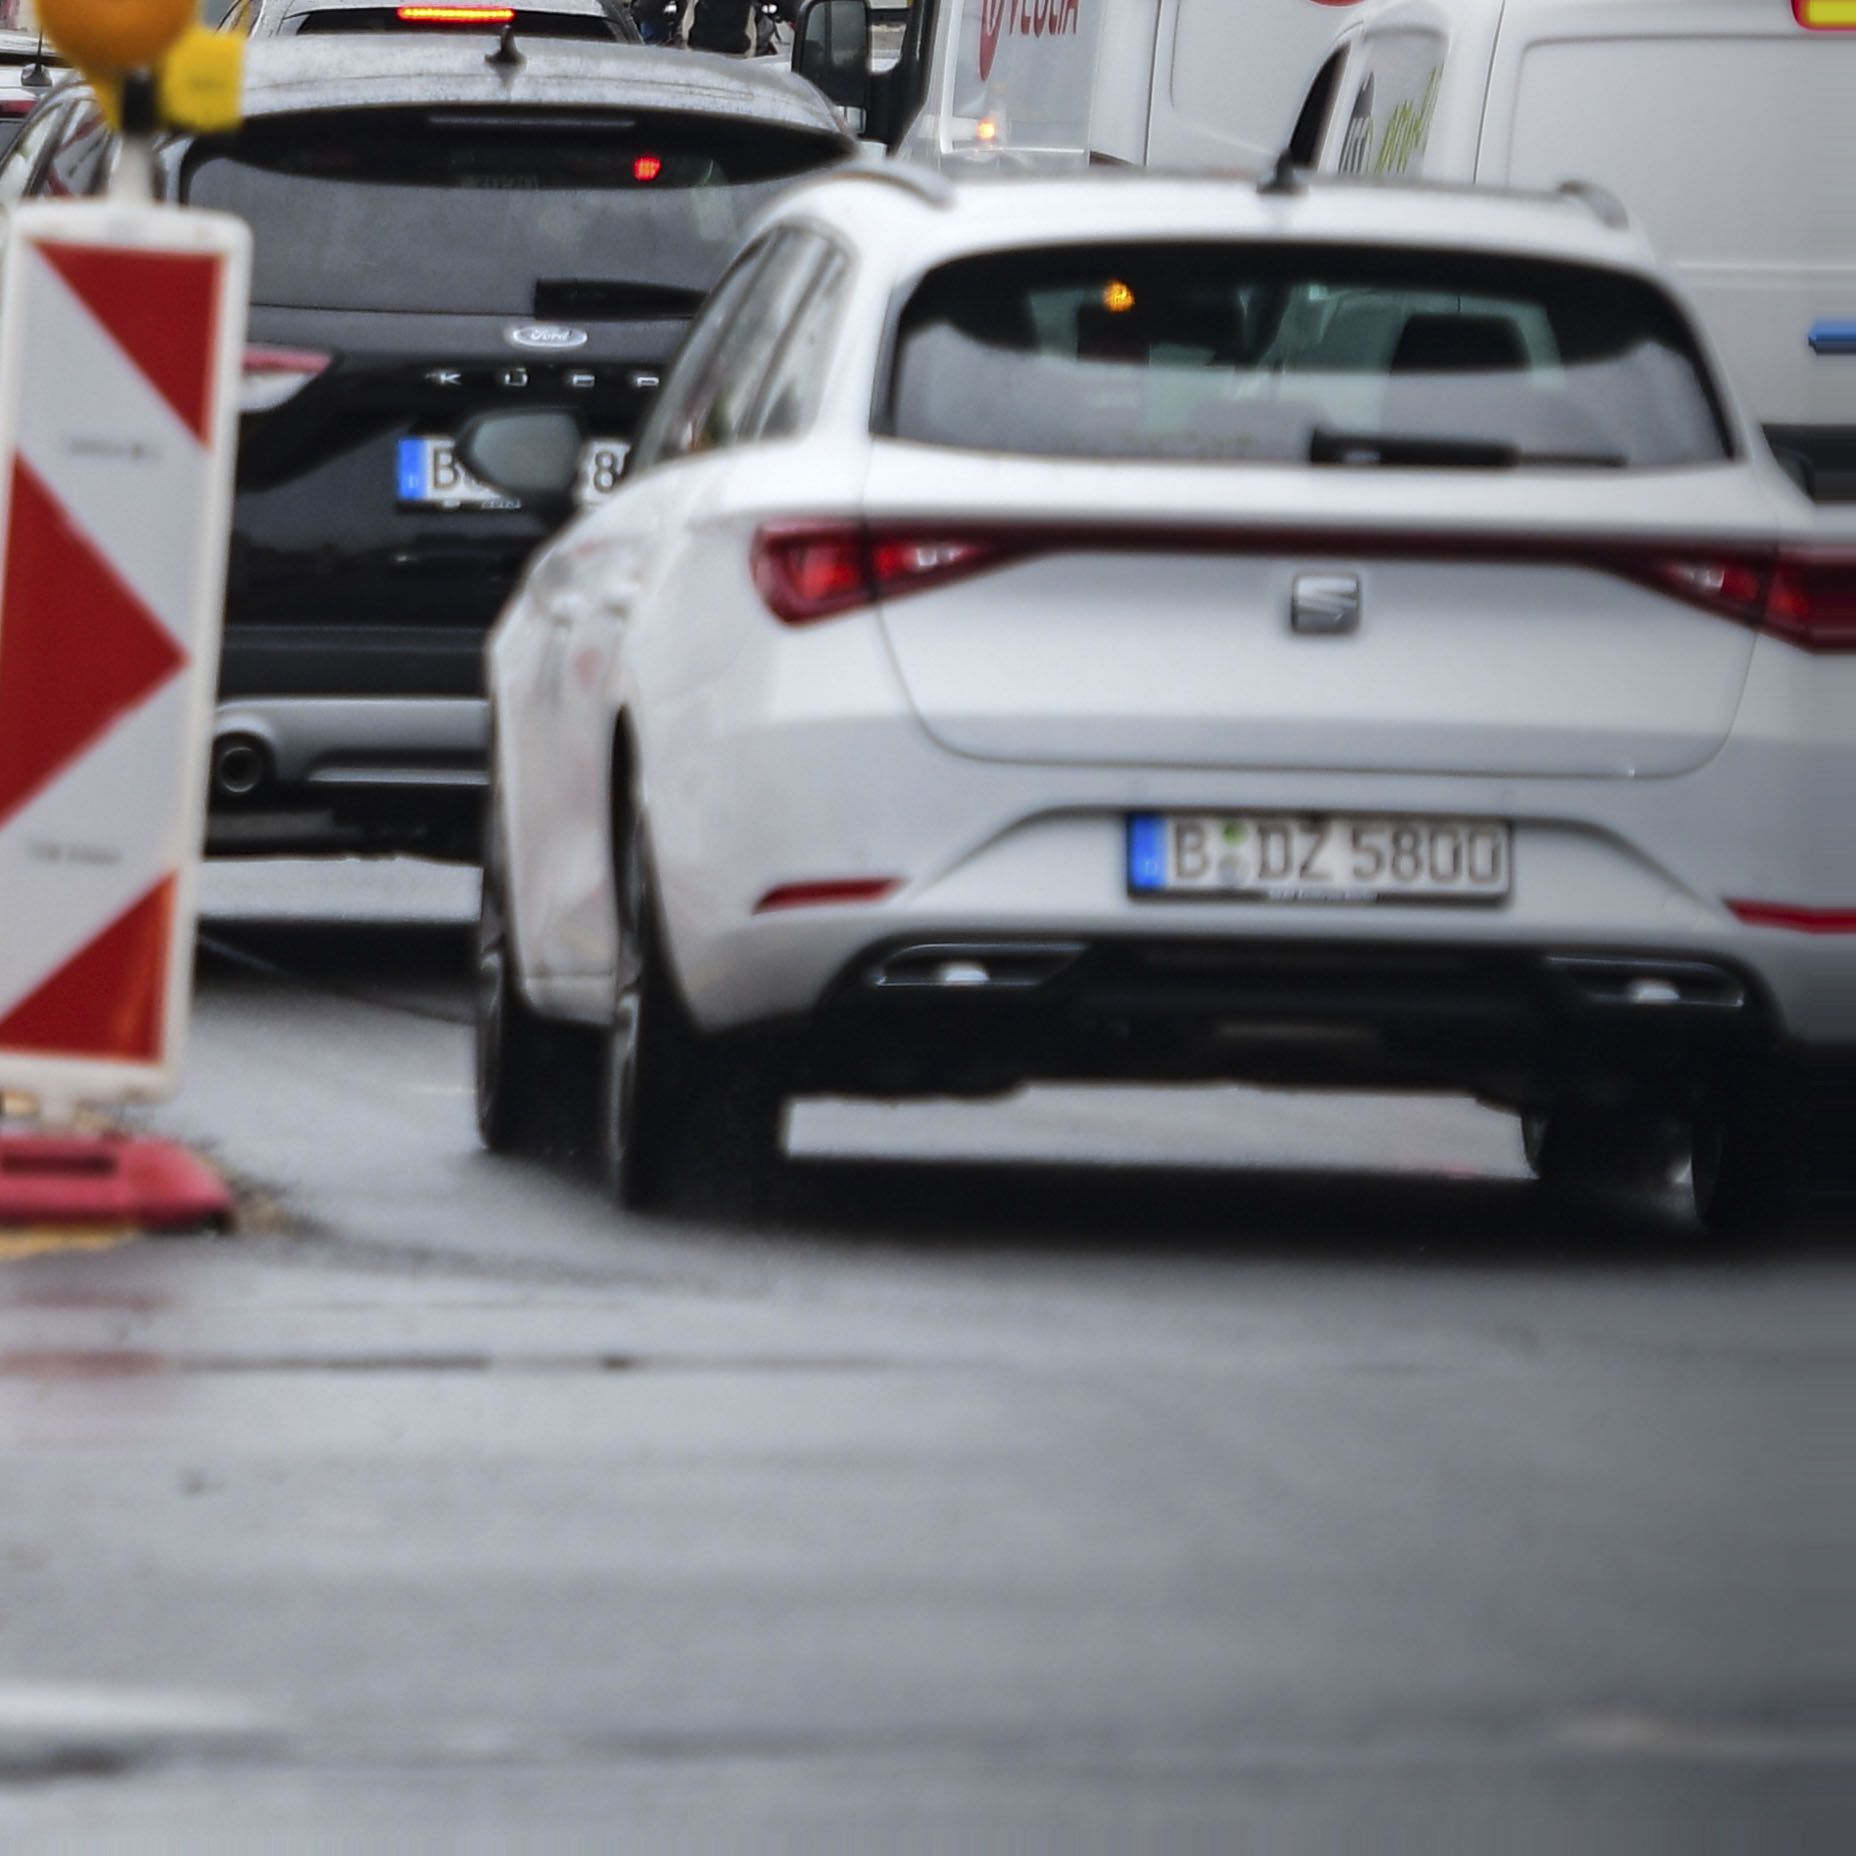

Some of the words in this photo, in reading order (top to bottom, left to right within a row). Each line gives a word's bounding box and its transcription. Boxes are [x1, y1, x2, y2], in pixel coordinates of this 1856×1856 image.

[1173, 823, 1210, 880] B
[1258, 824, 1334, 883] DZ
[1350, 825, 1502, 885] 5800
